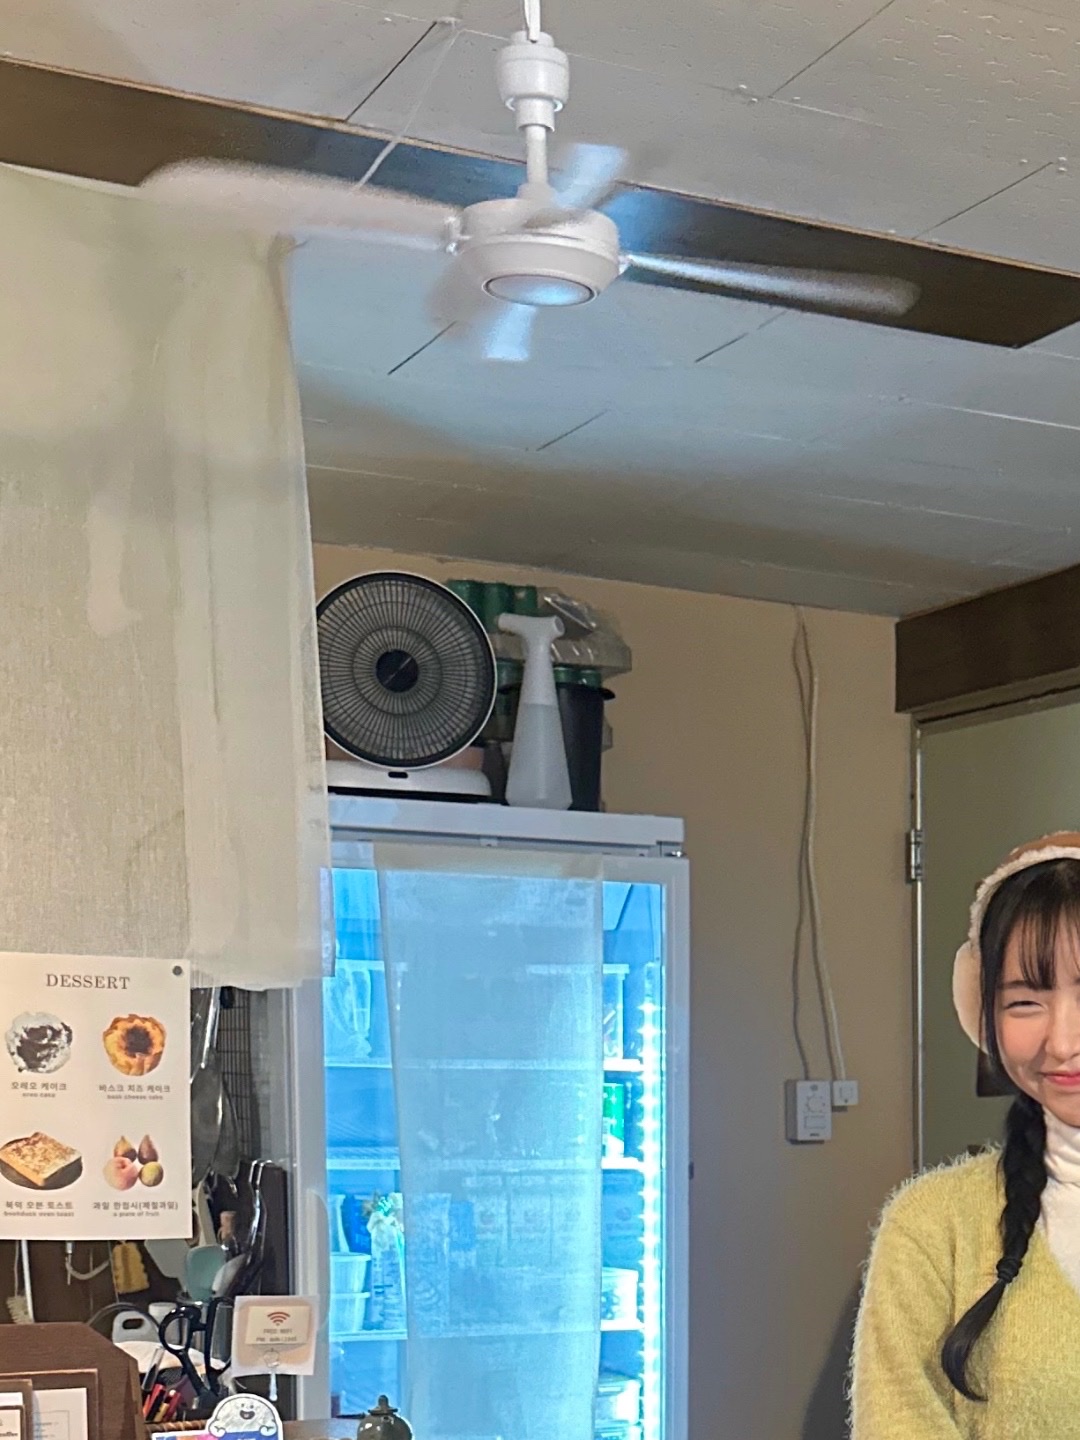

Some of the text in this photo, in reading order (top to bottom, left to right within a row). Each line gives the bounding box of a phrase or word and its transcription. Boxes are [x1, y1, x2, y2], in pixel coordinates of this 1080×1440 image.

[45, 974, 131, 990] DESSERT
[11, 1081, 67, 1091] 오레오 케이크
[98, 1084, 171, 1093] 바스크 치즈 케이크
[47, 1201, 74, 1210] 토스트
[92, 1201, 110, 1210] 과일
